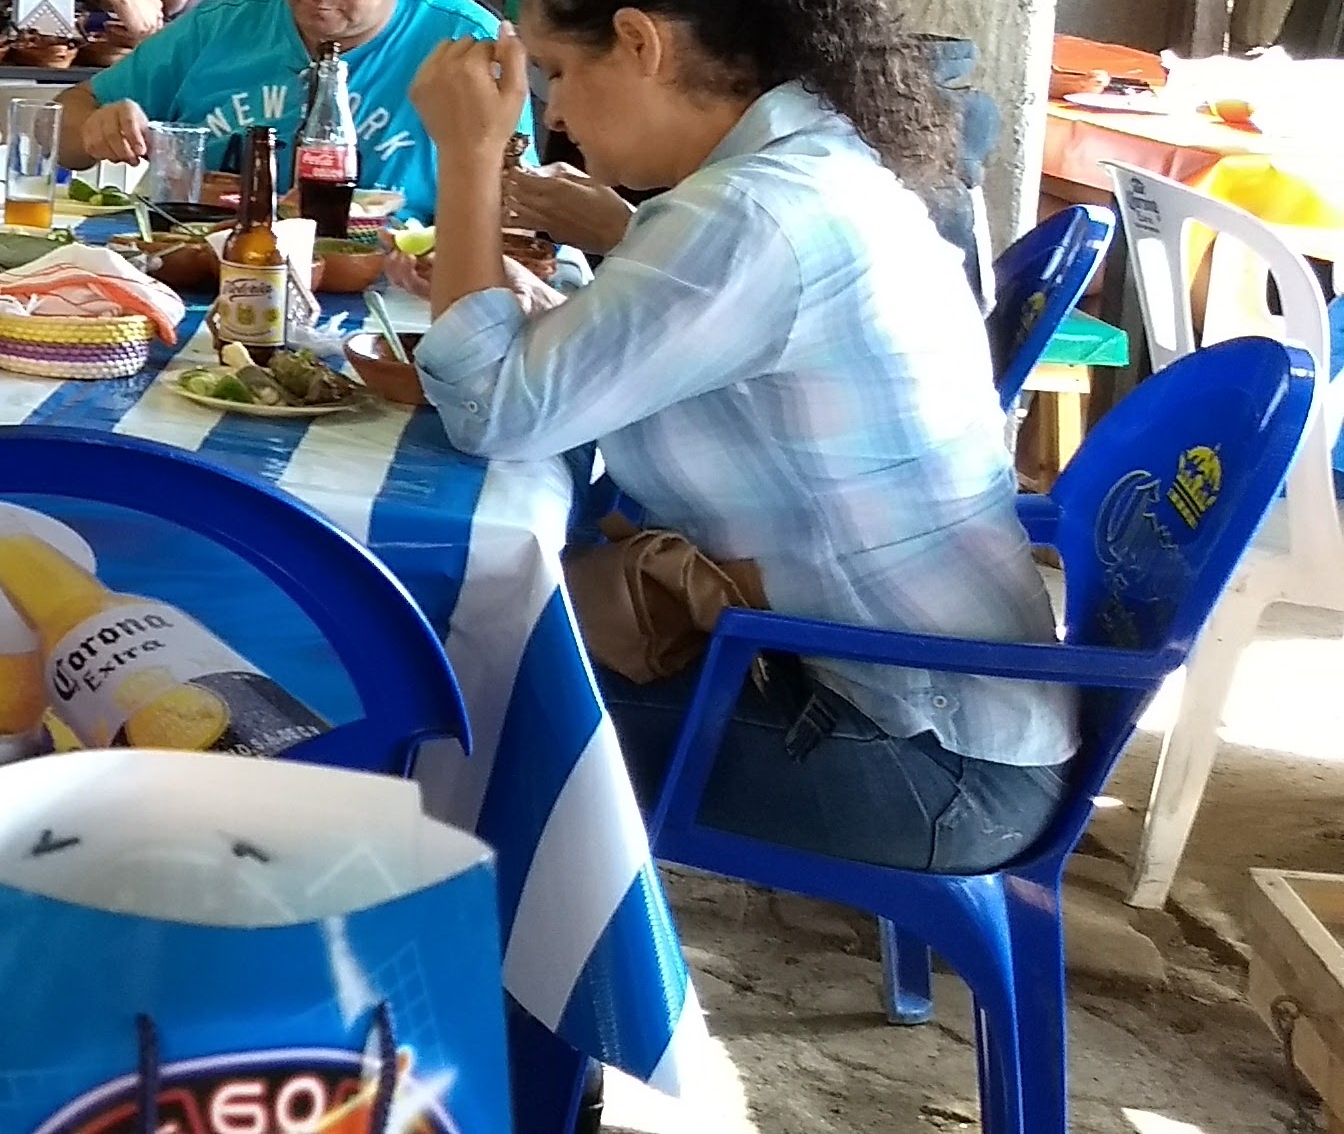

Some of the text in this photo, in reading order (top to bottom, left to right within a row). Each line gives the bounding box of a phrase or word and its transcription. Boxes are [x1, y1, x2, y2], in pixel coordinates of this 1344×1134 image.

[205, 85, 288, 138] NEW
[52, 614, 174, 702] Corona
[83, 637, 166, 693] Extra
